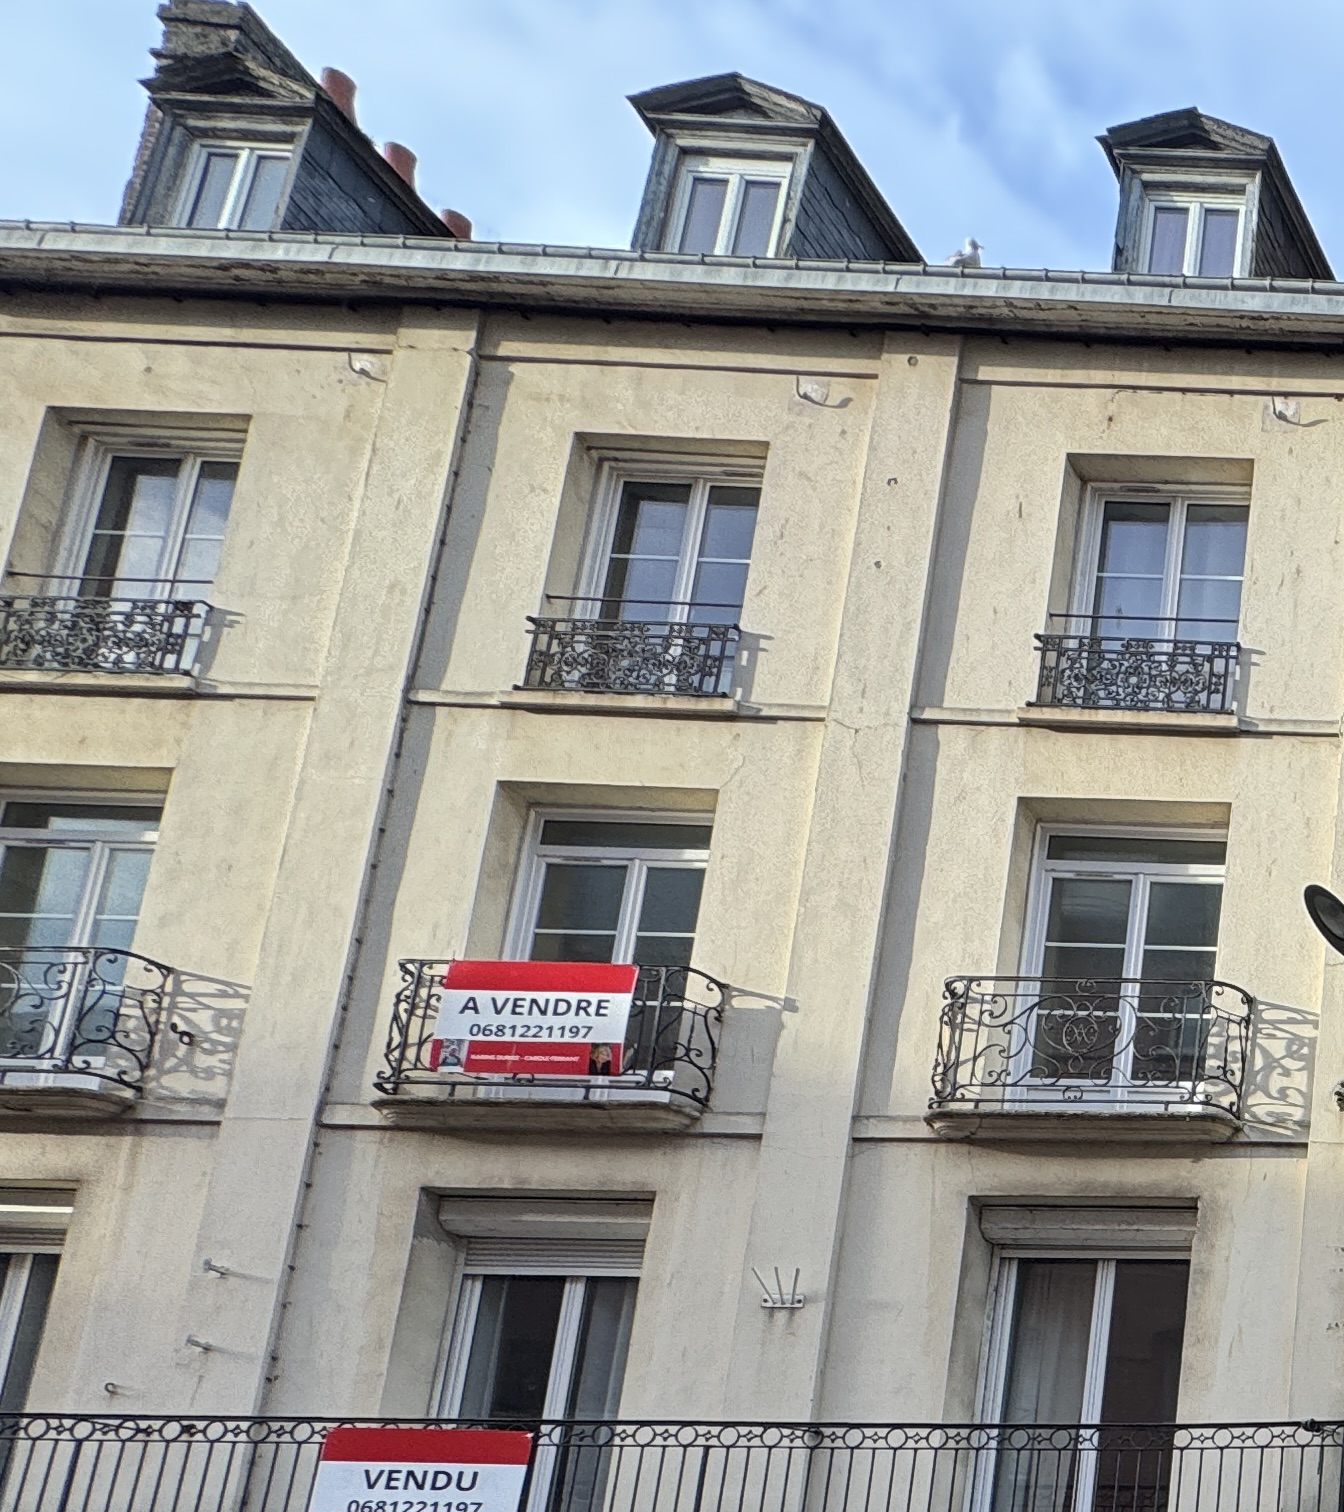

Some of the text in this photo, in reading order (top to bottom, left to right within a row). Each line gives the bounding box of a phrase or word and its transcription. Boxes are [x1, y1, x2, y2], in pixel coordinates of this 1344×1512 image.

[459, 996, 611, 1017] A VENDRE
[469, 1023, 594, 1039] 0681221197
[364, 1469, 480, 1492] VENDU
